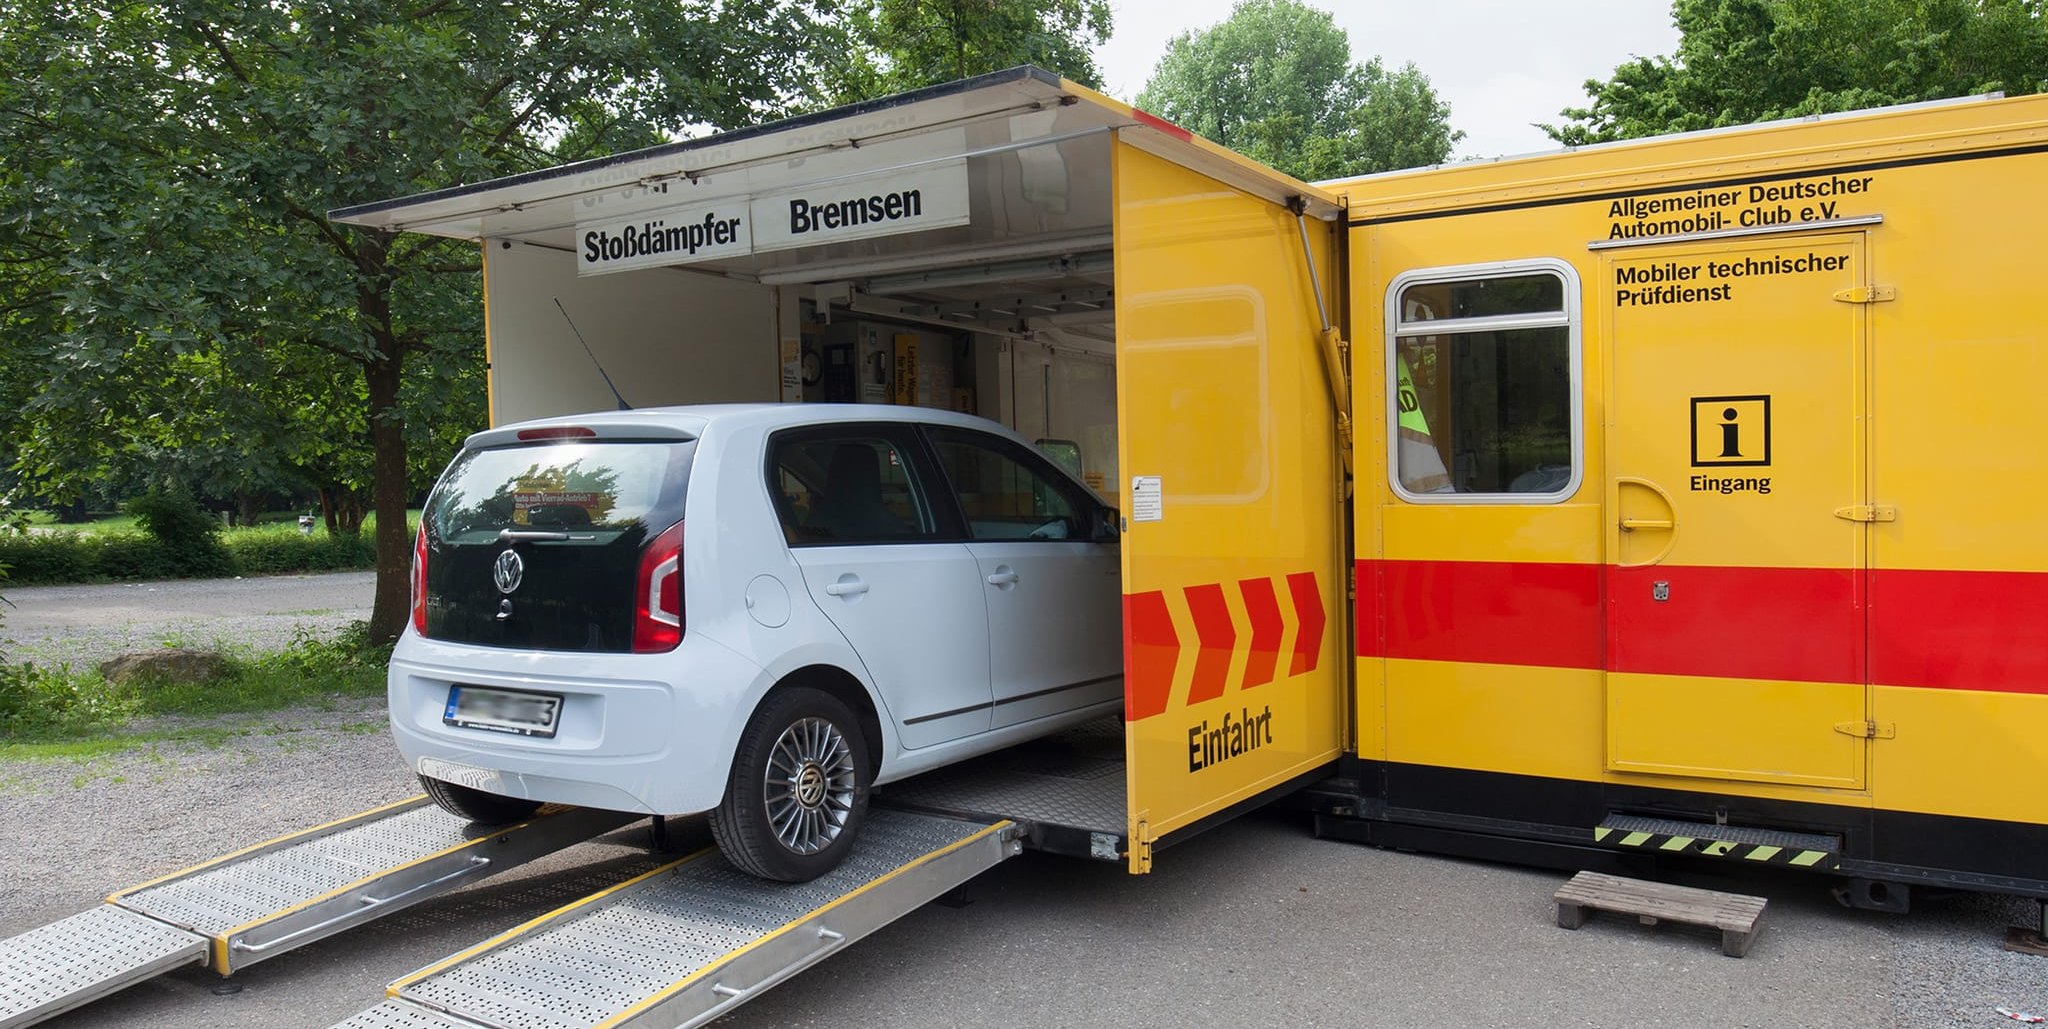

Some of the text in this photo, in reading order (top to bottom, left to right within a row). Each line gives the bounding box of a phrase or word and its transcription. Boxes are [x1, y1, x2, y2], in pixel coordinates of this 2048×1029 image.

[789, 189, 922, 234] Bremsen
[1608, 176, 1873, 219] Allgemeiner Deutscher
[584, 212, 741, 263] Stoßdämpfer
[1609, 201, 1841, 240] Automobil- Club e.V.
[1615, 252, 1849, 285] Mobiler technischer
[1615, 283, 1732, 307] Prüfdienst
[1690, 474, 1772, 495] Eingang
[1188, 705, 1272, 774] Einfahrt
